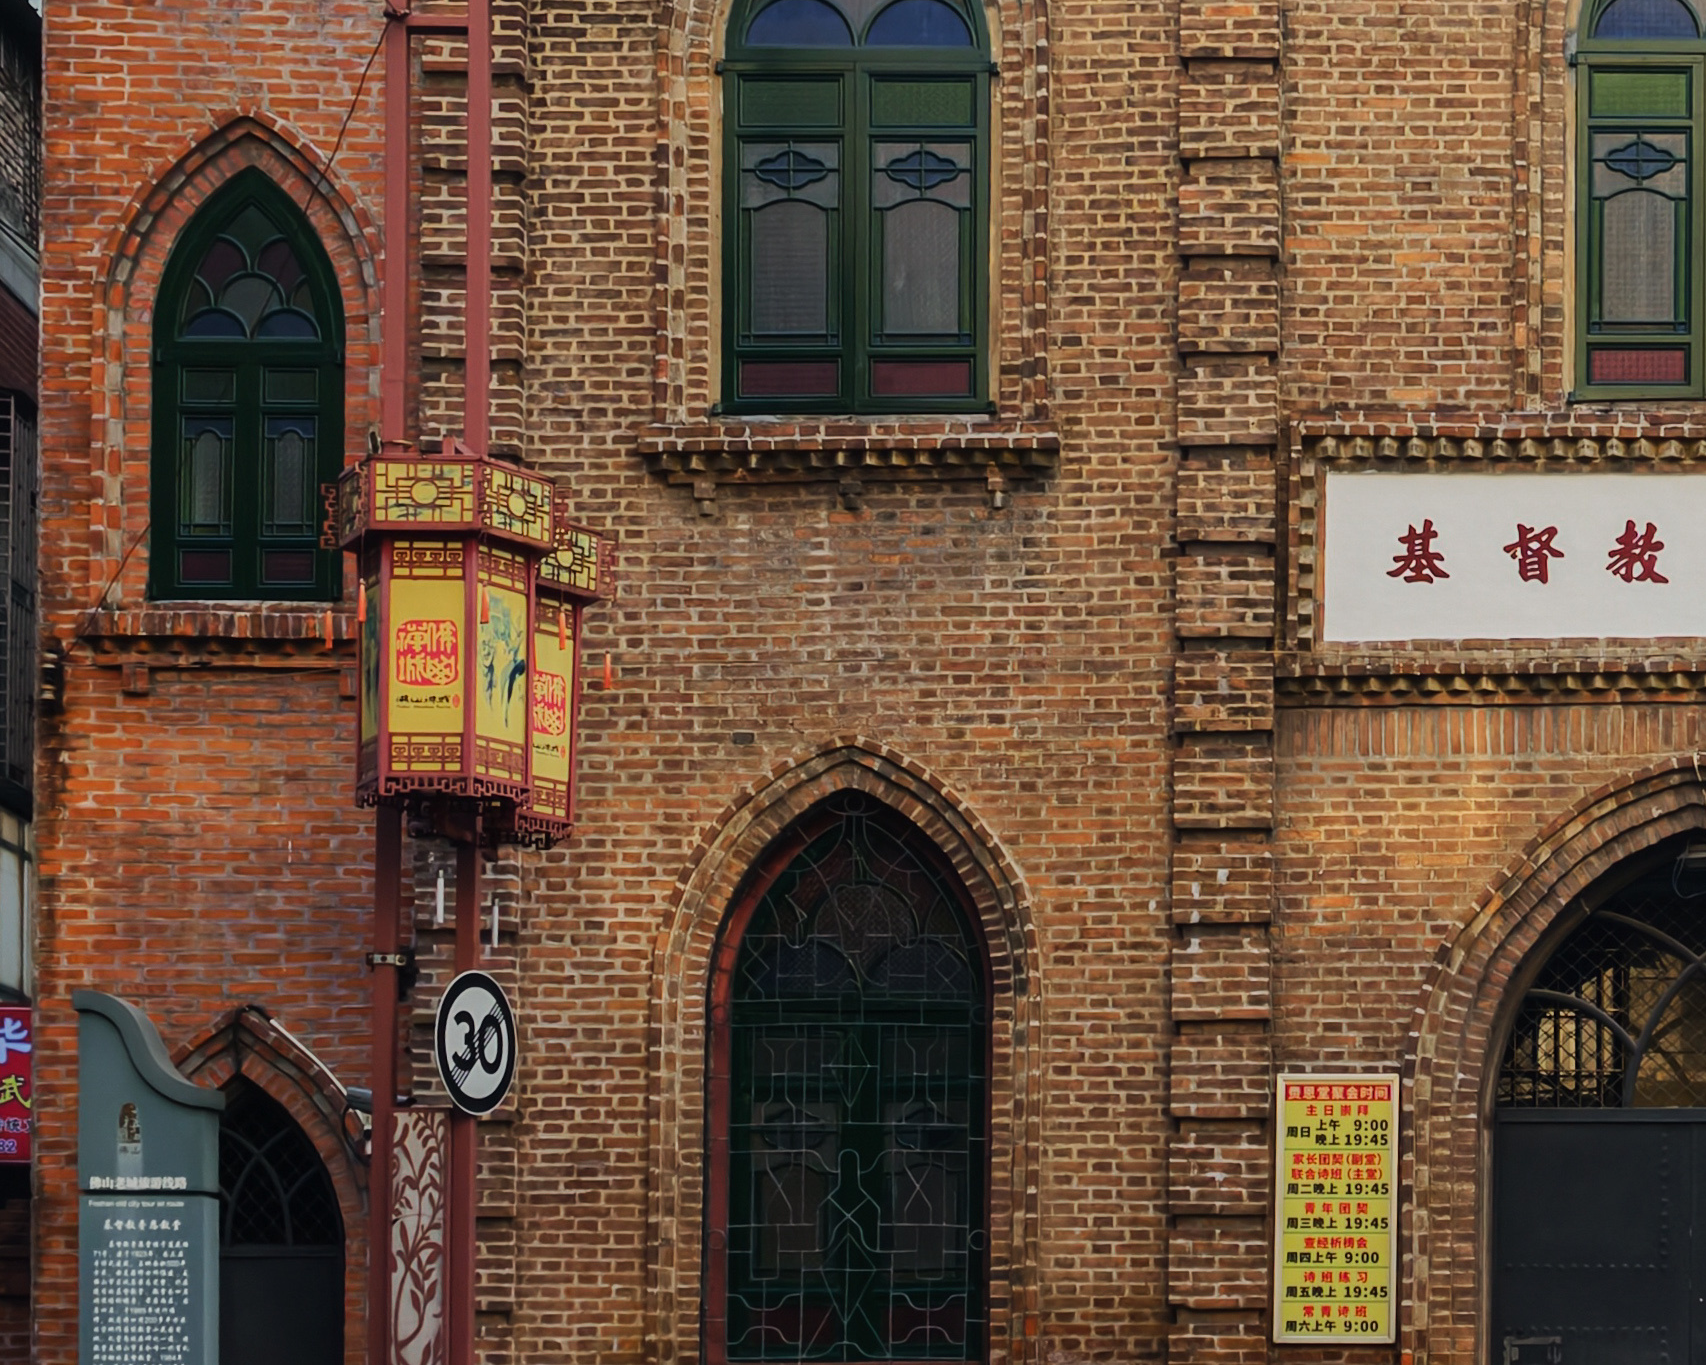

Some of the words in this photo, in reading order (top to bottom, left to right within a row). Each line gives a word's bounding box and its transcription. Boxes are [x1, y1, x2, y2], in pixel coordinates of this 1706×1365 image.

[452, 1010, 504, 1075] 30
[1306, 1104, 1369, 1116] 主日崇拜
[1316, 1119, 1340, 1131] 上午
[1354, 1119, 1389, 1131] 9:00
[1286, 1126, 1311, 1138] 周日
[1315, 1134, 1340, 1146] 晚上
[1344, 1134, 1388, 1146] 19:45
[1287, 1182, 1339, 1195] 周二晚上
[1345, 1183, 1390, 1195] 19:45
[1305, 1202, 1368, 1215] 青年团契
[1286, 1217, 1338, 1229] 周三晚上
[1345, 1217, 1389, 1229] 19:45
[1286, 1251, 1337, 1264] 周四上午
[1344, 1251, 1379, 1264] 9:00
[1303, 1271, 1368, 1283] 诗班练习
[1285, 1285, 1337, 1298] 周五晚上
[1344, 1285, 1388, 1298] 19:45
[1285, 1320, 1336, 1333] 周六上午
[1343, 1320, 1379, 1332] 9:00
